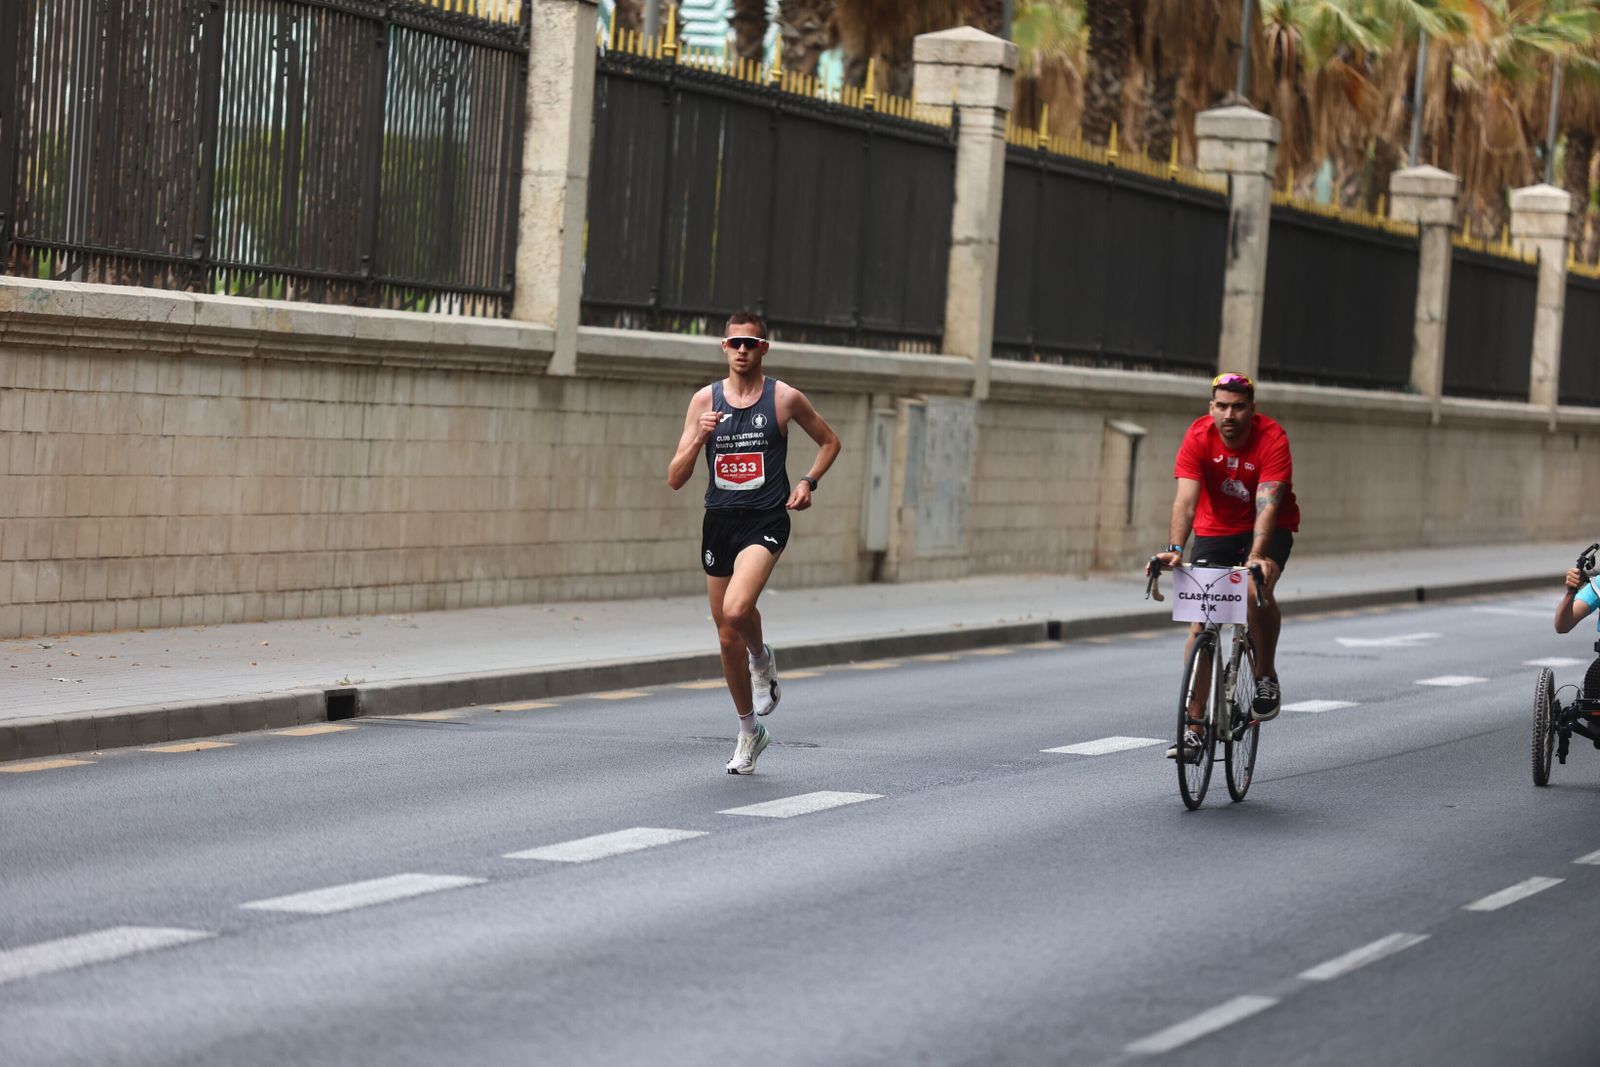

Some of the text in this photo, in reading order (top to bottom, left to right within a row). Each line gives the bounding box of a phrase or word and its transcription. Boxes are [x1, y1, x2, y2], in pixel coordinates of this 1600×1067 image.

[732, 432, 764, 441] ATLETISMO
[720, 462, 757, 473] 2333
[1178, 592, 1242, 602] CLASIFICADO
